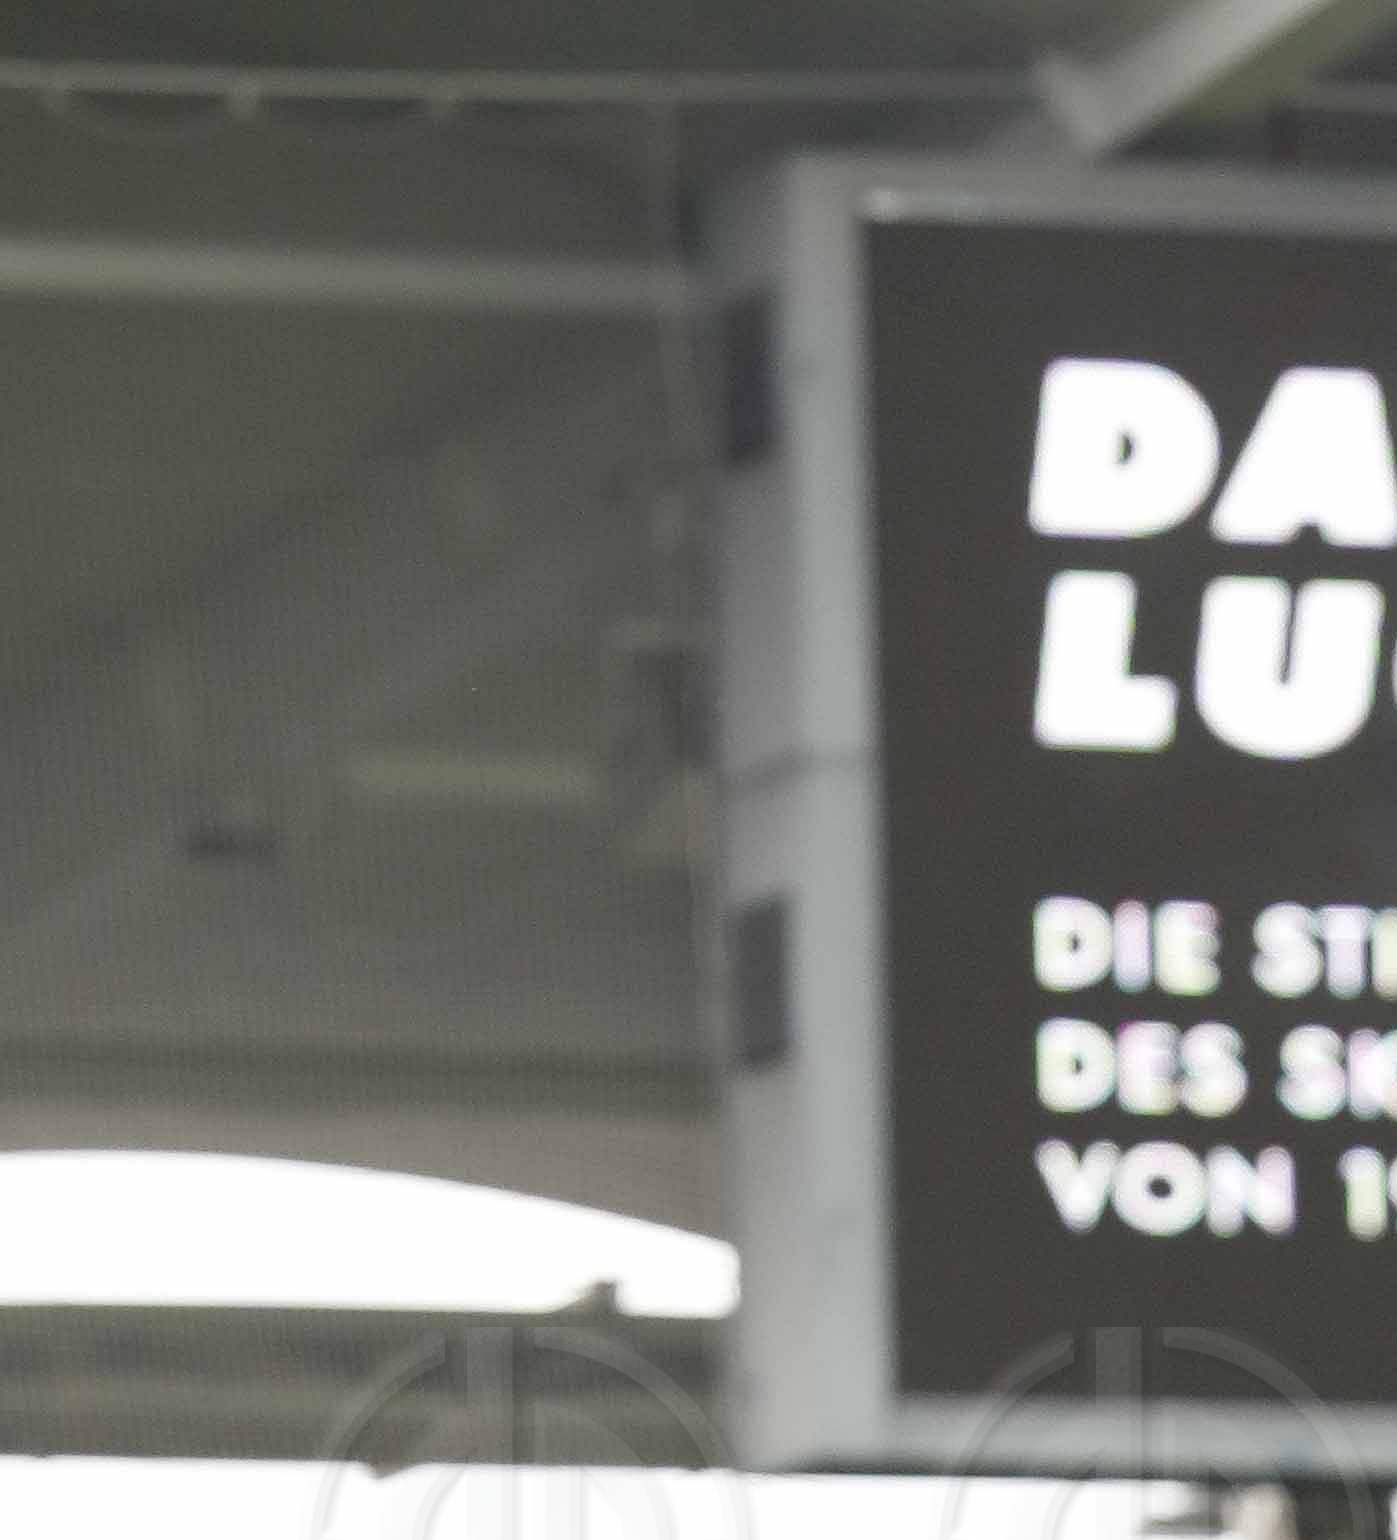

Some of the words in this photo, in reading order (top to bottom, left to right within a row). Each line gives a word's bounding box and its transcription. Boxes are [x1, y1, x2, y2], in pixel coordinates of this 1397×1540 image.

[1034, 896, 1222, 997] DIE
[1035, 1017, 1248, 1117] DES
[1035, 1139, 1297, 1236] VON
